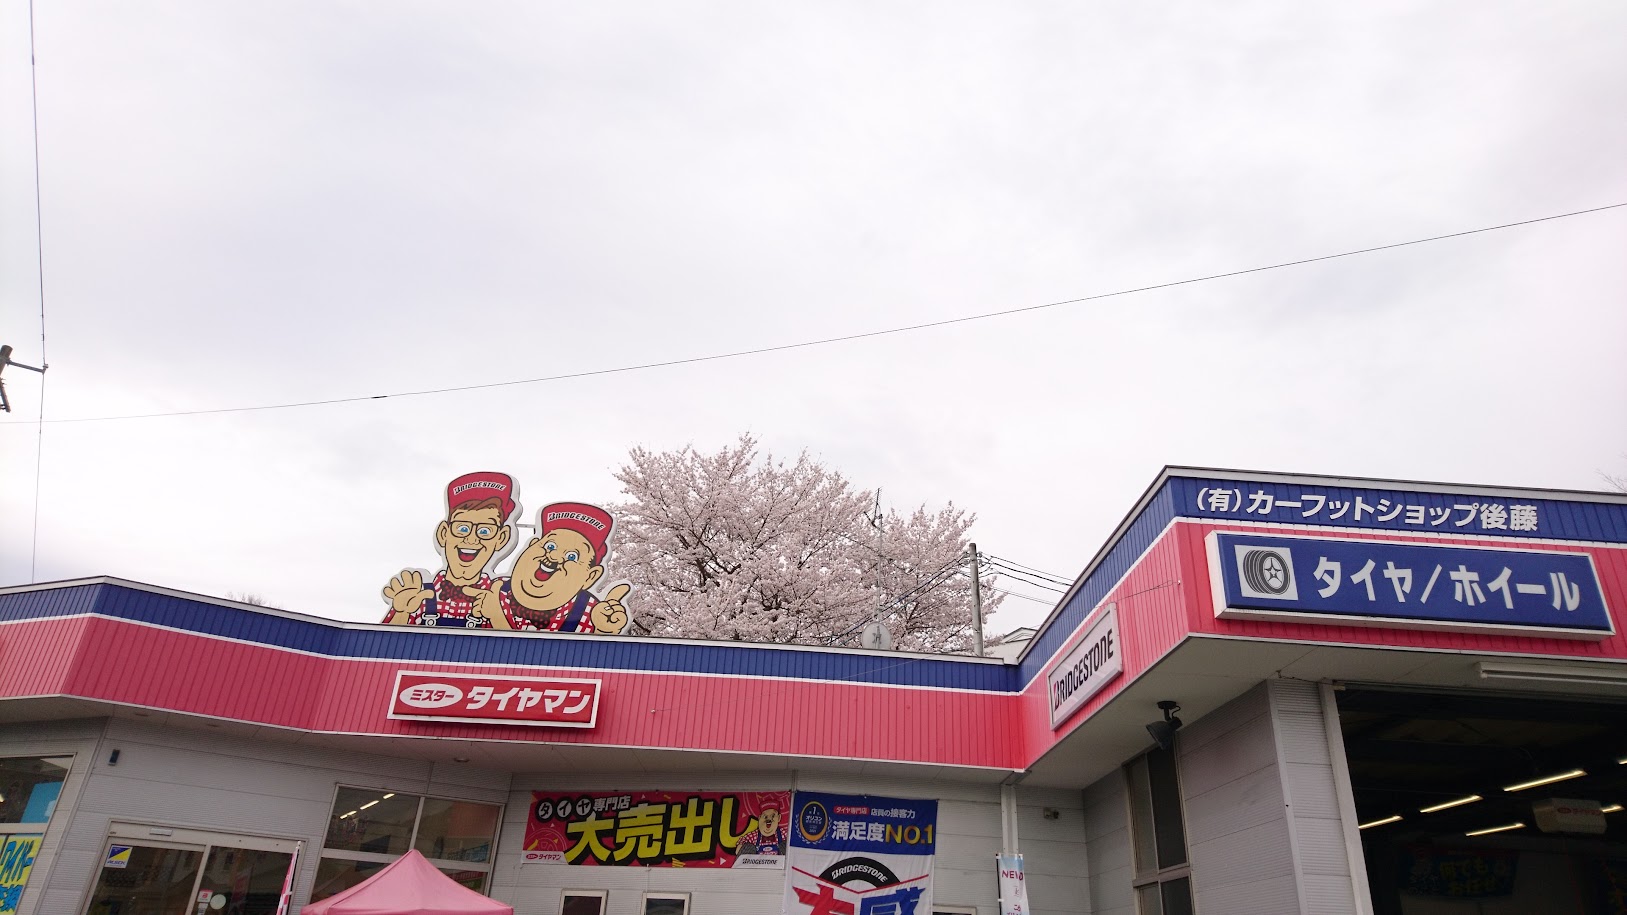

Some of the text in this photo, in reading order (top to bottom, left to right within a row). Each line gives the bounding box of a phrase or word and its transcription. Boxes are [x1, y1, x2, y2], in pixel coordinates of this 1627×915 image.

[453, 480, 507, 495] BRIDGESTONE
[1196, 487, 1539, 532] (有)カーフットショップ後藤
[547, 512, 606, 531] BRIDGESTONE
[1053, 627, 1114, 713] BRIDGESTONE
[409, 686, 591, 714] ミスター タイヤマン
[538, 795, 631, 819] タイヤ専門店
[836, 807, 916, 819] タイヤ専門店 店員の接客力
[564, 797, 759, 863] 大売出し
[538, 853, 562, 861] タイヤマン
[831, 864, 888, 883] BRIDGESTONE
